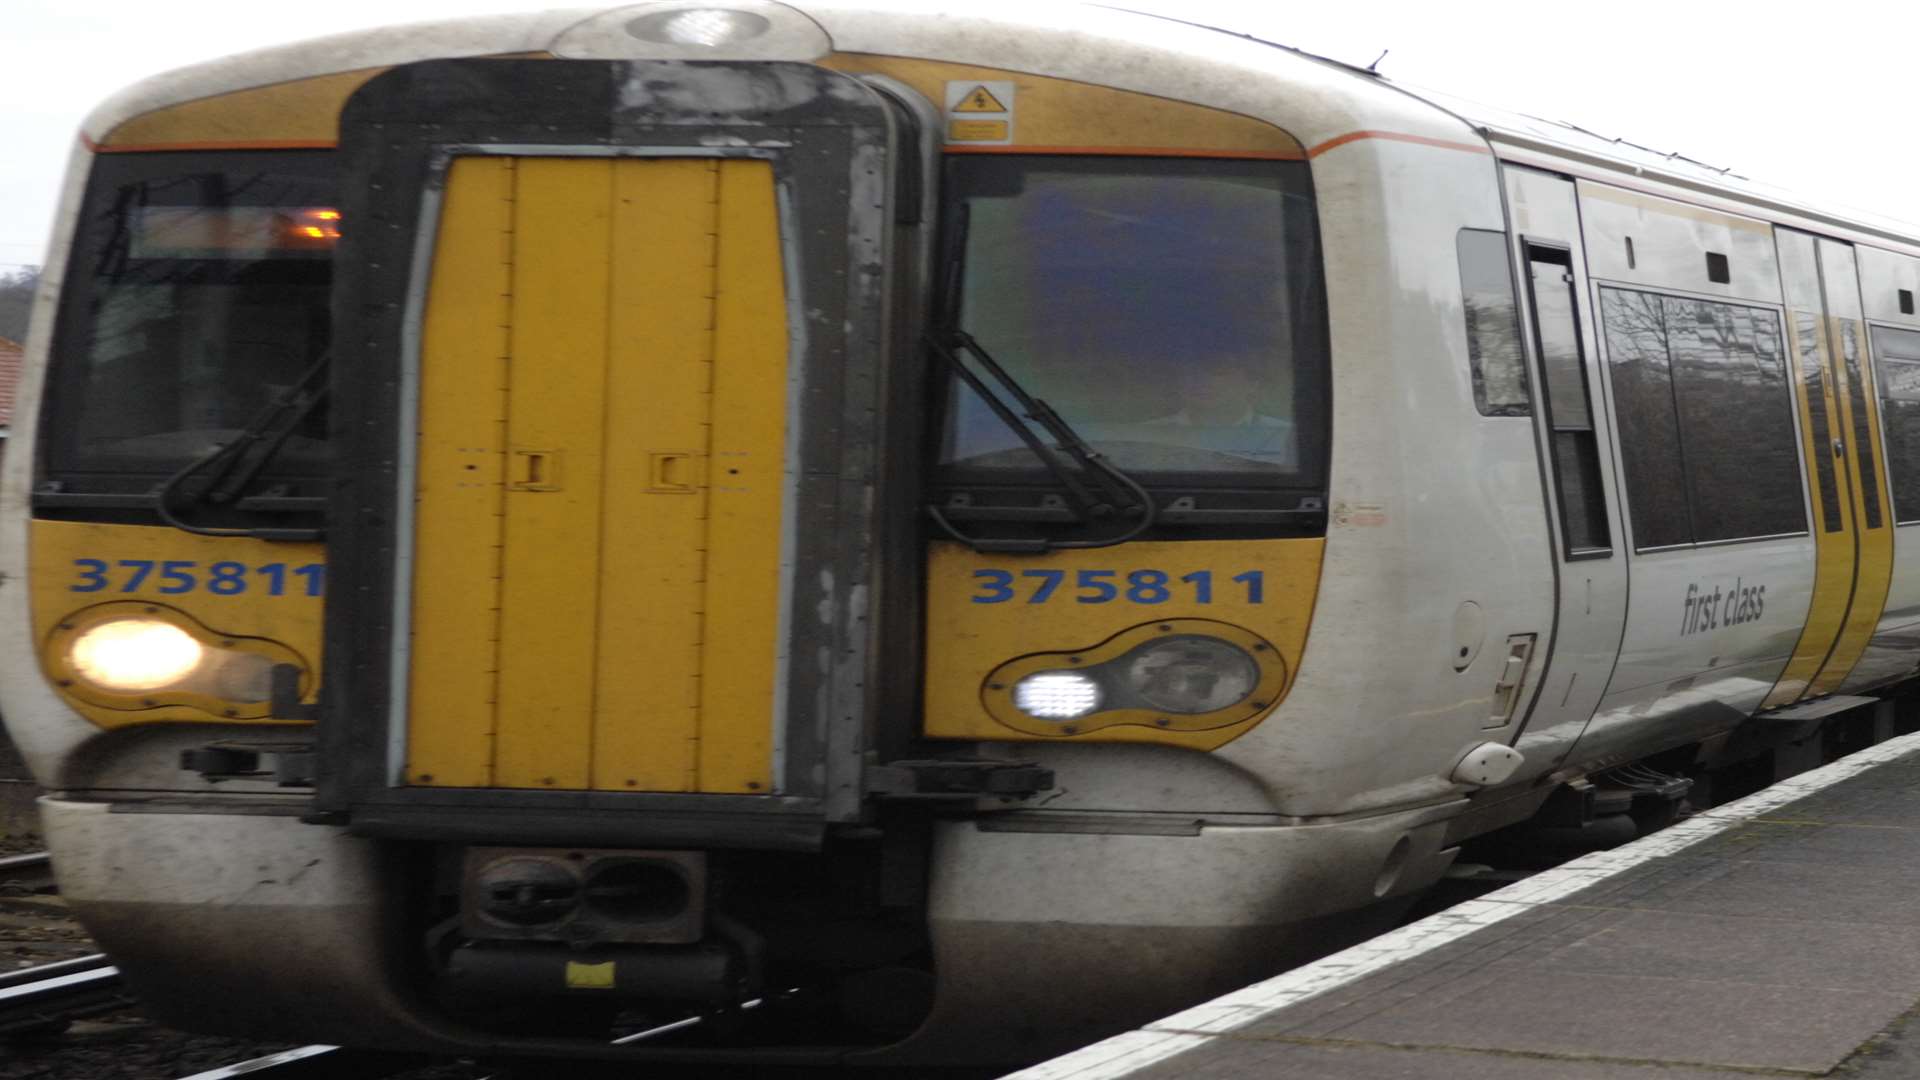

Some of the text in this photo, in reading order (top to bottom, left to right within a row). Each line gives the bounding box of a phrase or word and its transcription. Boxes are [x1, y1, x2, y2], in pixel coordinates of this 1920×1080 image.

[70, 558, 325, 597] 375811
[971, 569, 1264, 604] 375811
[1680, 576, 1765, 636] first class
